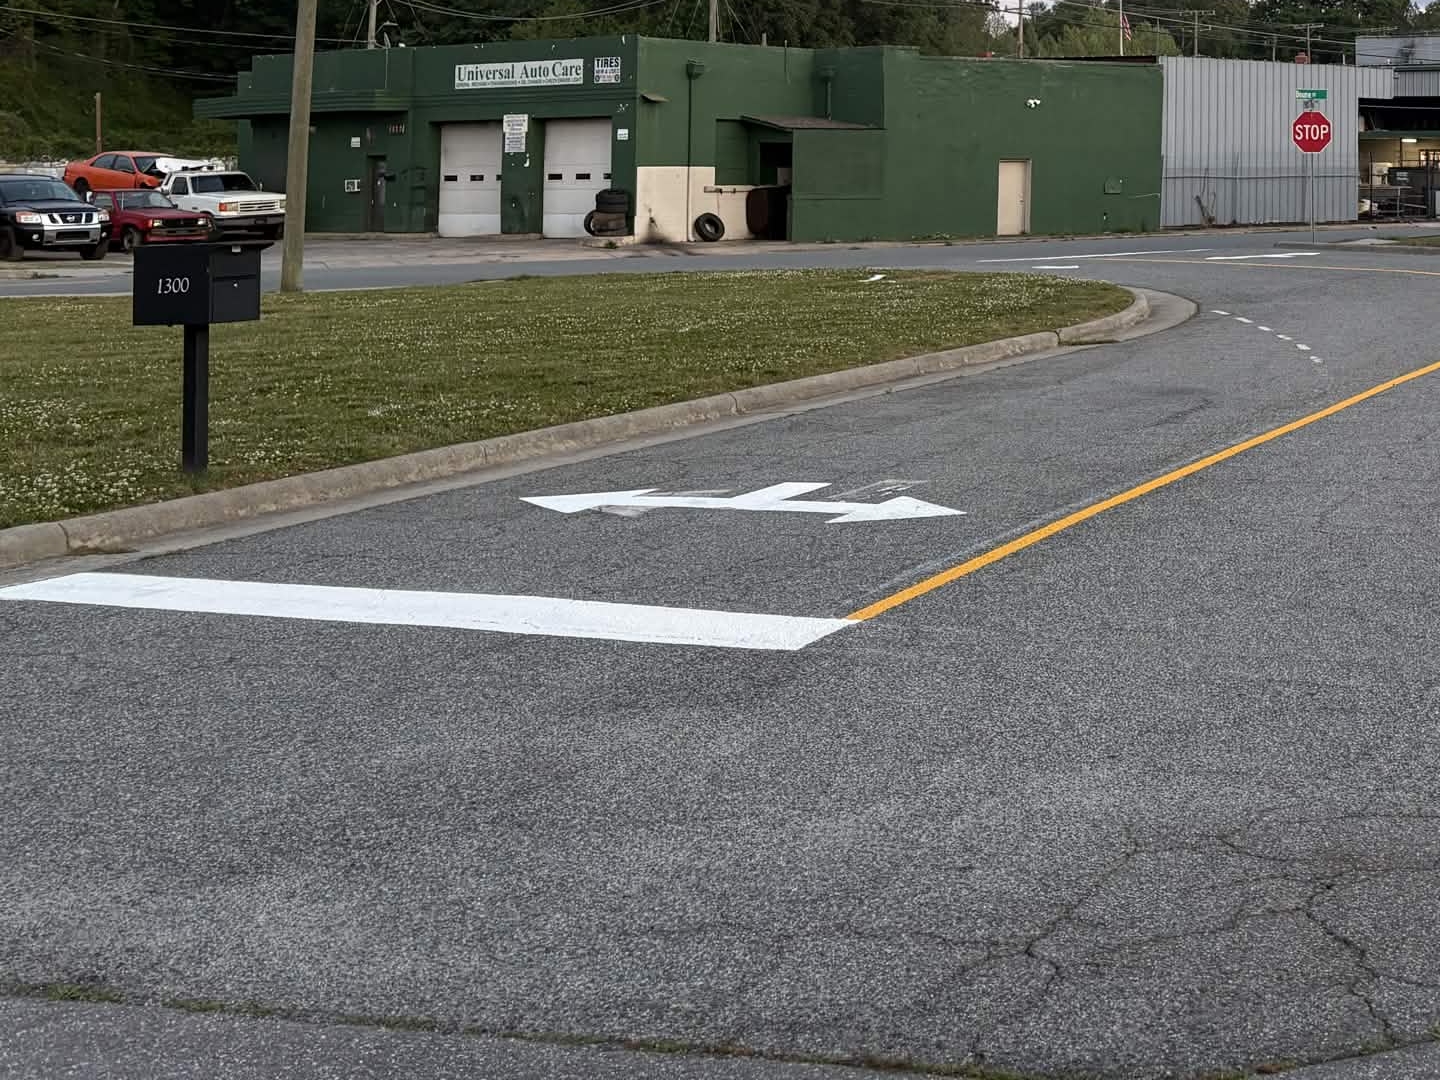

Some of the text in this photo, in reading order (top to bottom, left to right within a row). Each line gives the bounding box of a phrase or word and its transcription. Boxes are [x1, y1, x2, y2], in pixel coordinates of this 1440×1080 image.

[597, 57, 620, 68] TIRES
[457, 61, 582, 82] Universal Auto Care
[1295, 125, 1329, 140] STOP
[157, 277, 190, 294] 1300
